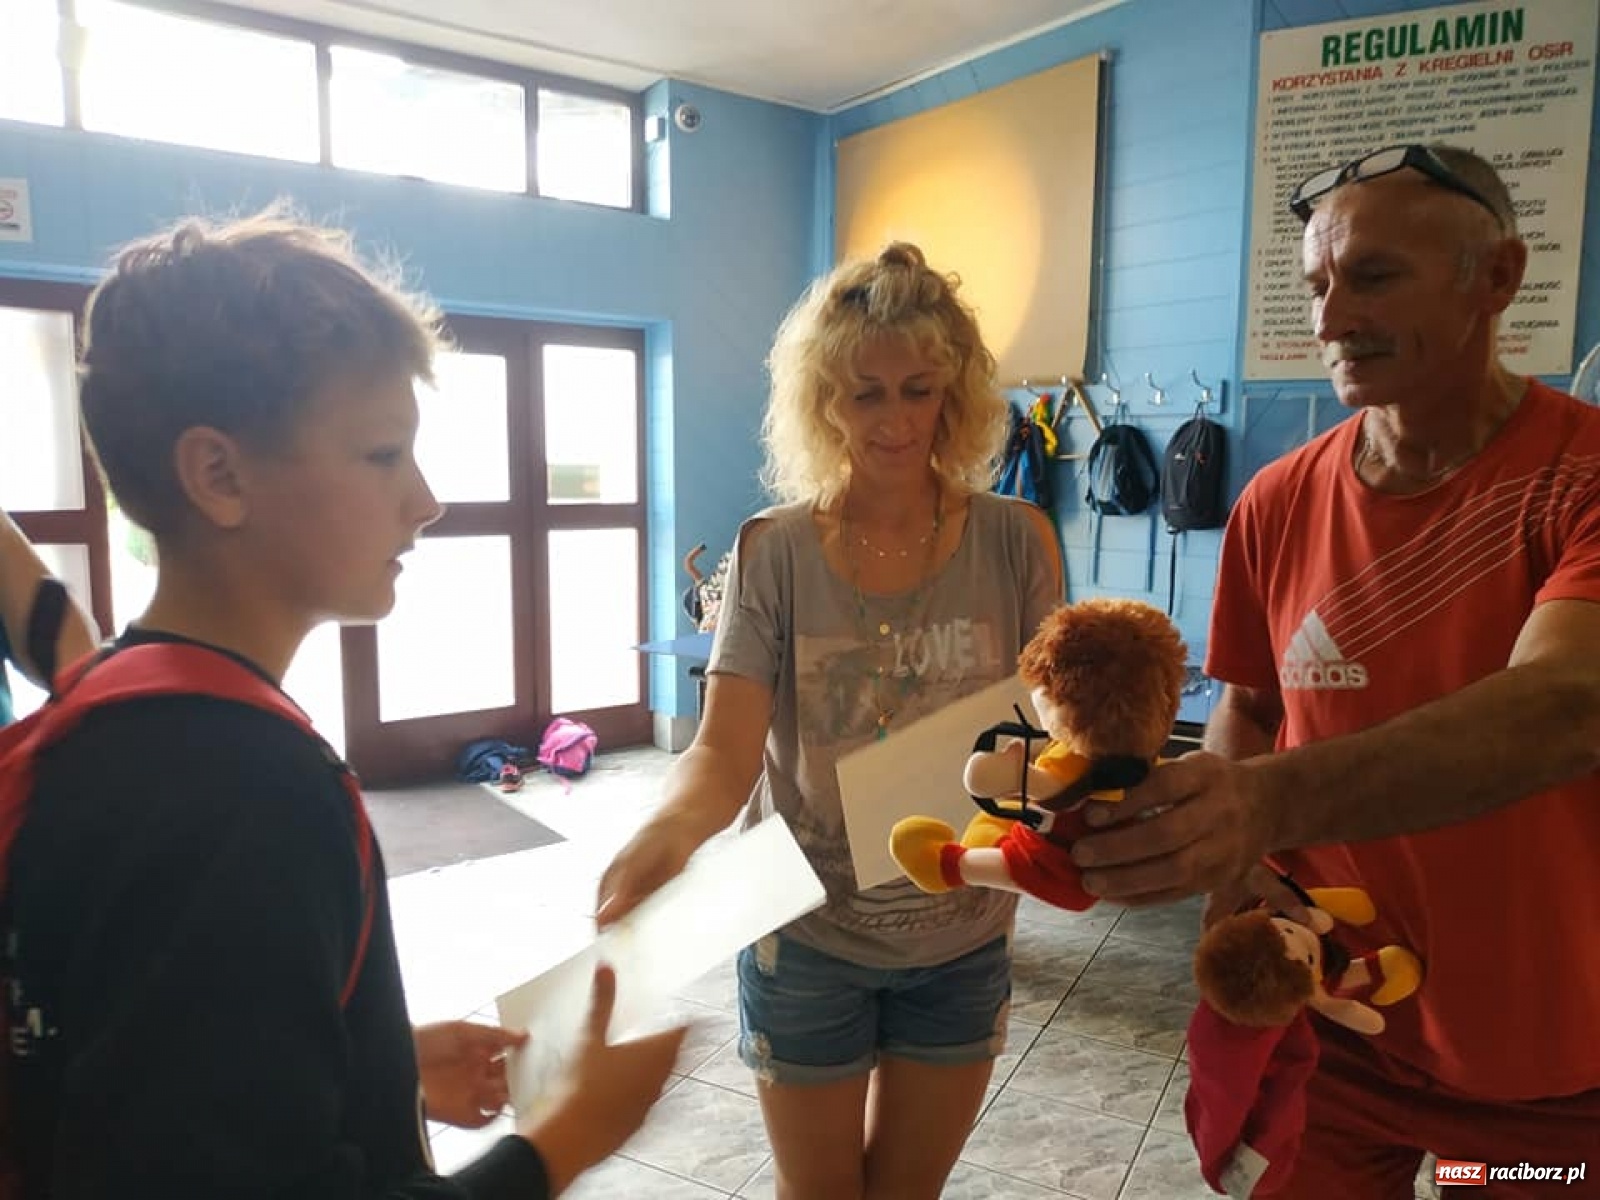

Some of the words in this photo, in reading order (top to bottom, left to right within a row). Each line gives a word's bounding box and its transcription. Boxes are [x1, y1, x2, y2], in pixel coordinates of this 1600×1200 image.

[1321, 8, 1524, 67] REGULAMIN
[1271, 66, 1383, 92] KORZYSTANIA
[1395, 61, 1407, 78] Z
[893, 617, 974, 678] LOVE
